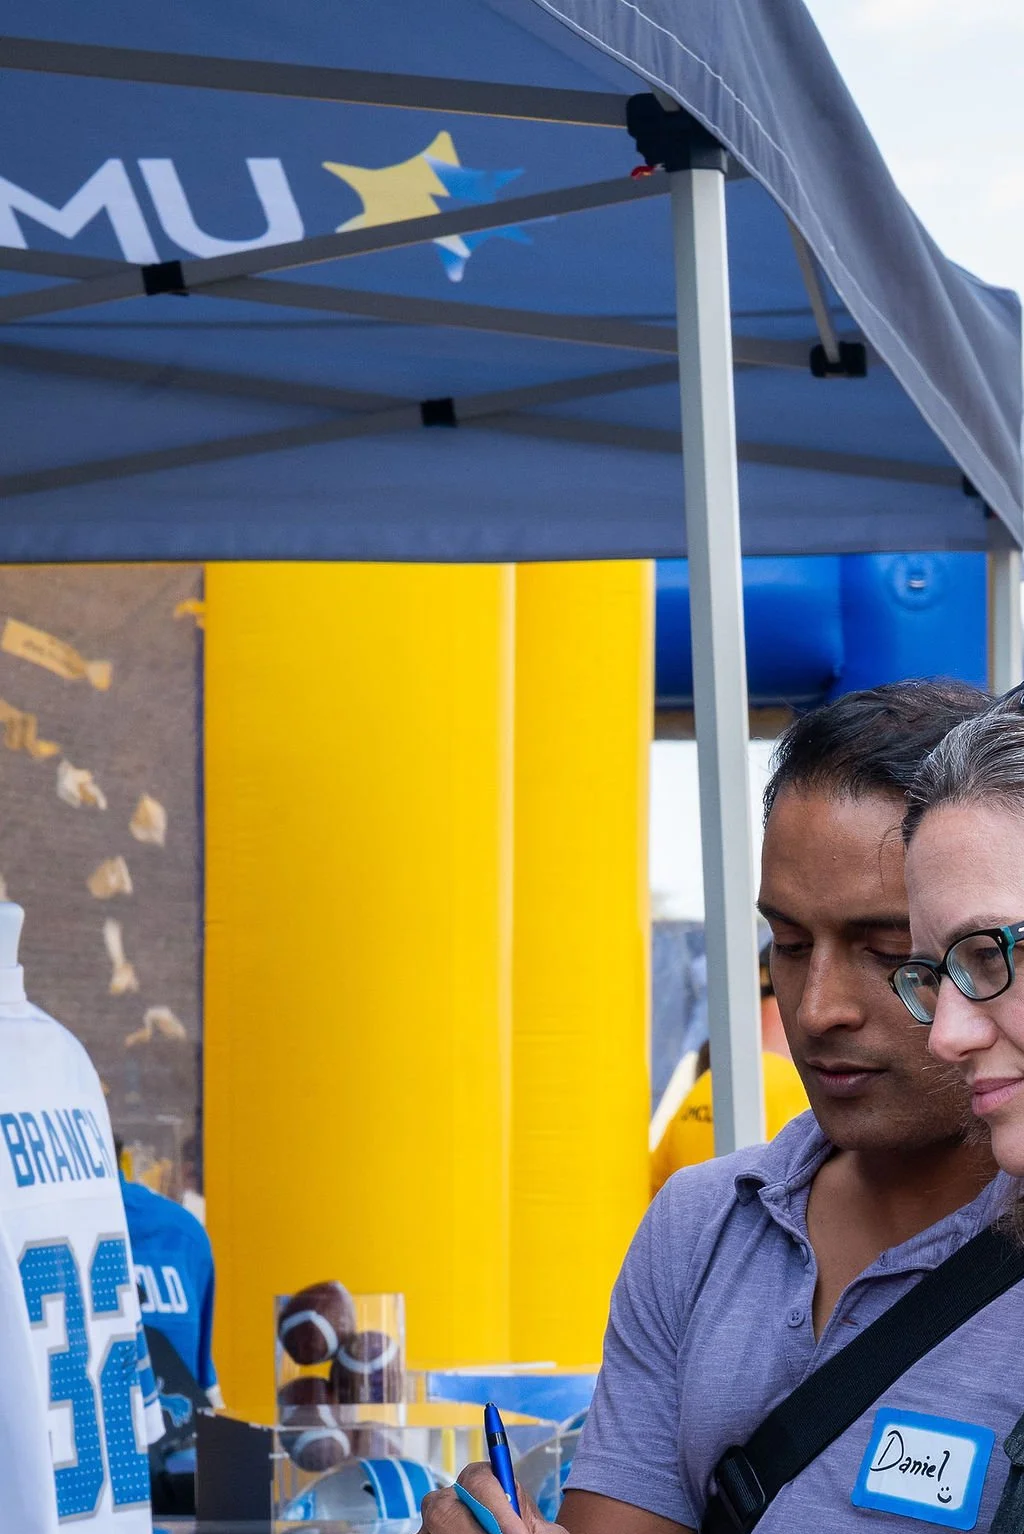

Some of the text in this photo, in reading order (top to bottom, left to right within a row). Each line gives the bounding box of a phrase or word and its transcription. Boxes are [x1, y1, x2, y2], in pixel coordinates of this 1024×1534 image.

[0, 1109, 115, 1187] BRANCH
[17, 1231, 151, 1525] 32
[870, 1430, 950, 1482] Daniel
